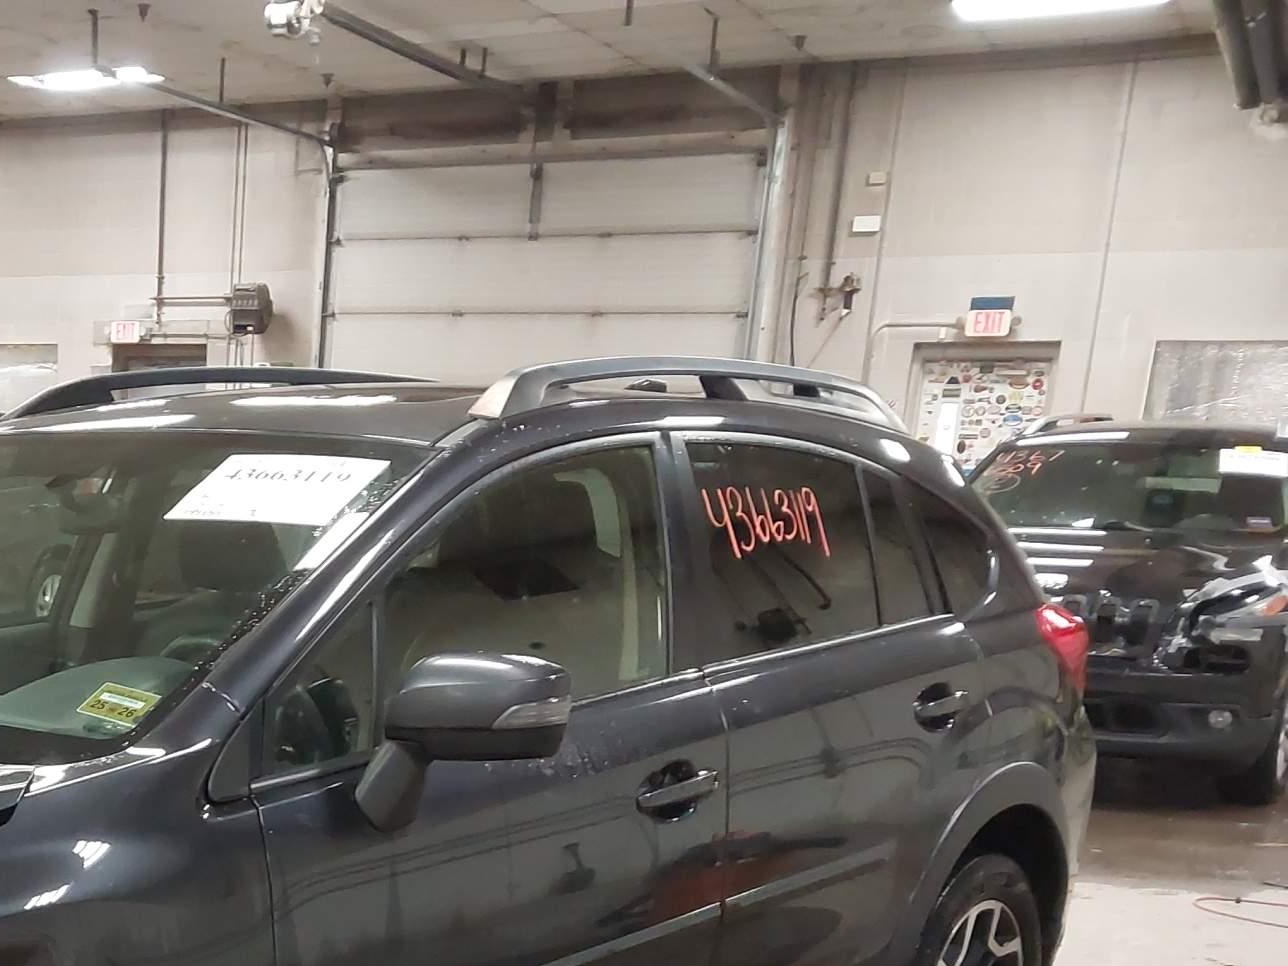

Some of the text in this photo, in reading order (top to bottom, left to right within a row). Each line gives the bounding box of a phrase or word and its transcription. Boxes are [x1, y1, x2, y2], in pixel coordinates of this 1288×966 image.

[973, 312, 1005, 333] EXIT
[701, 486, 830, 559] 43663119
[90, 700, 108, 710] 25
[117, 707, 137, 718] 26
